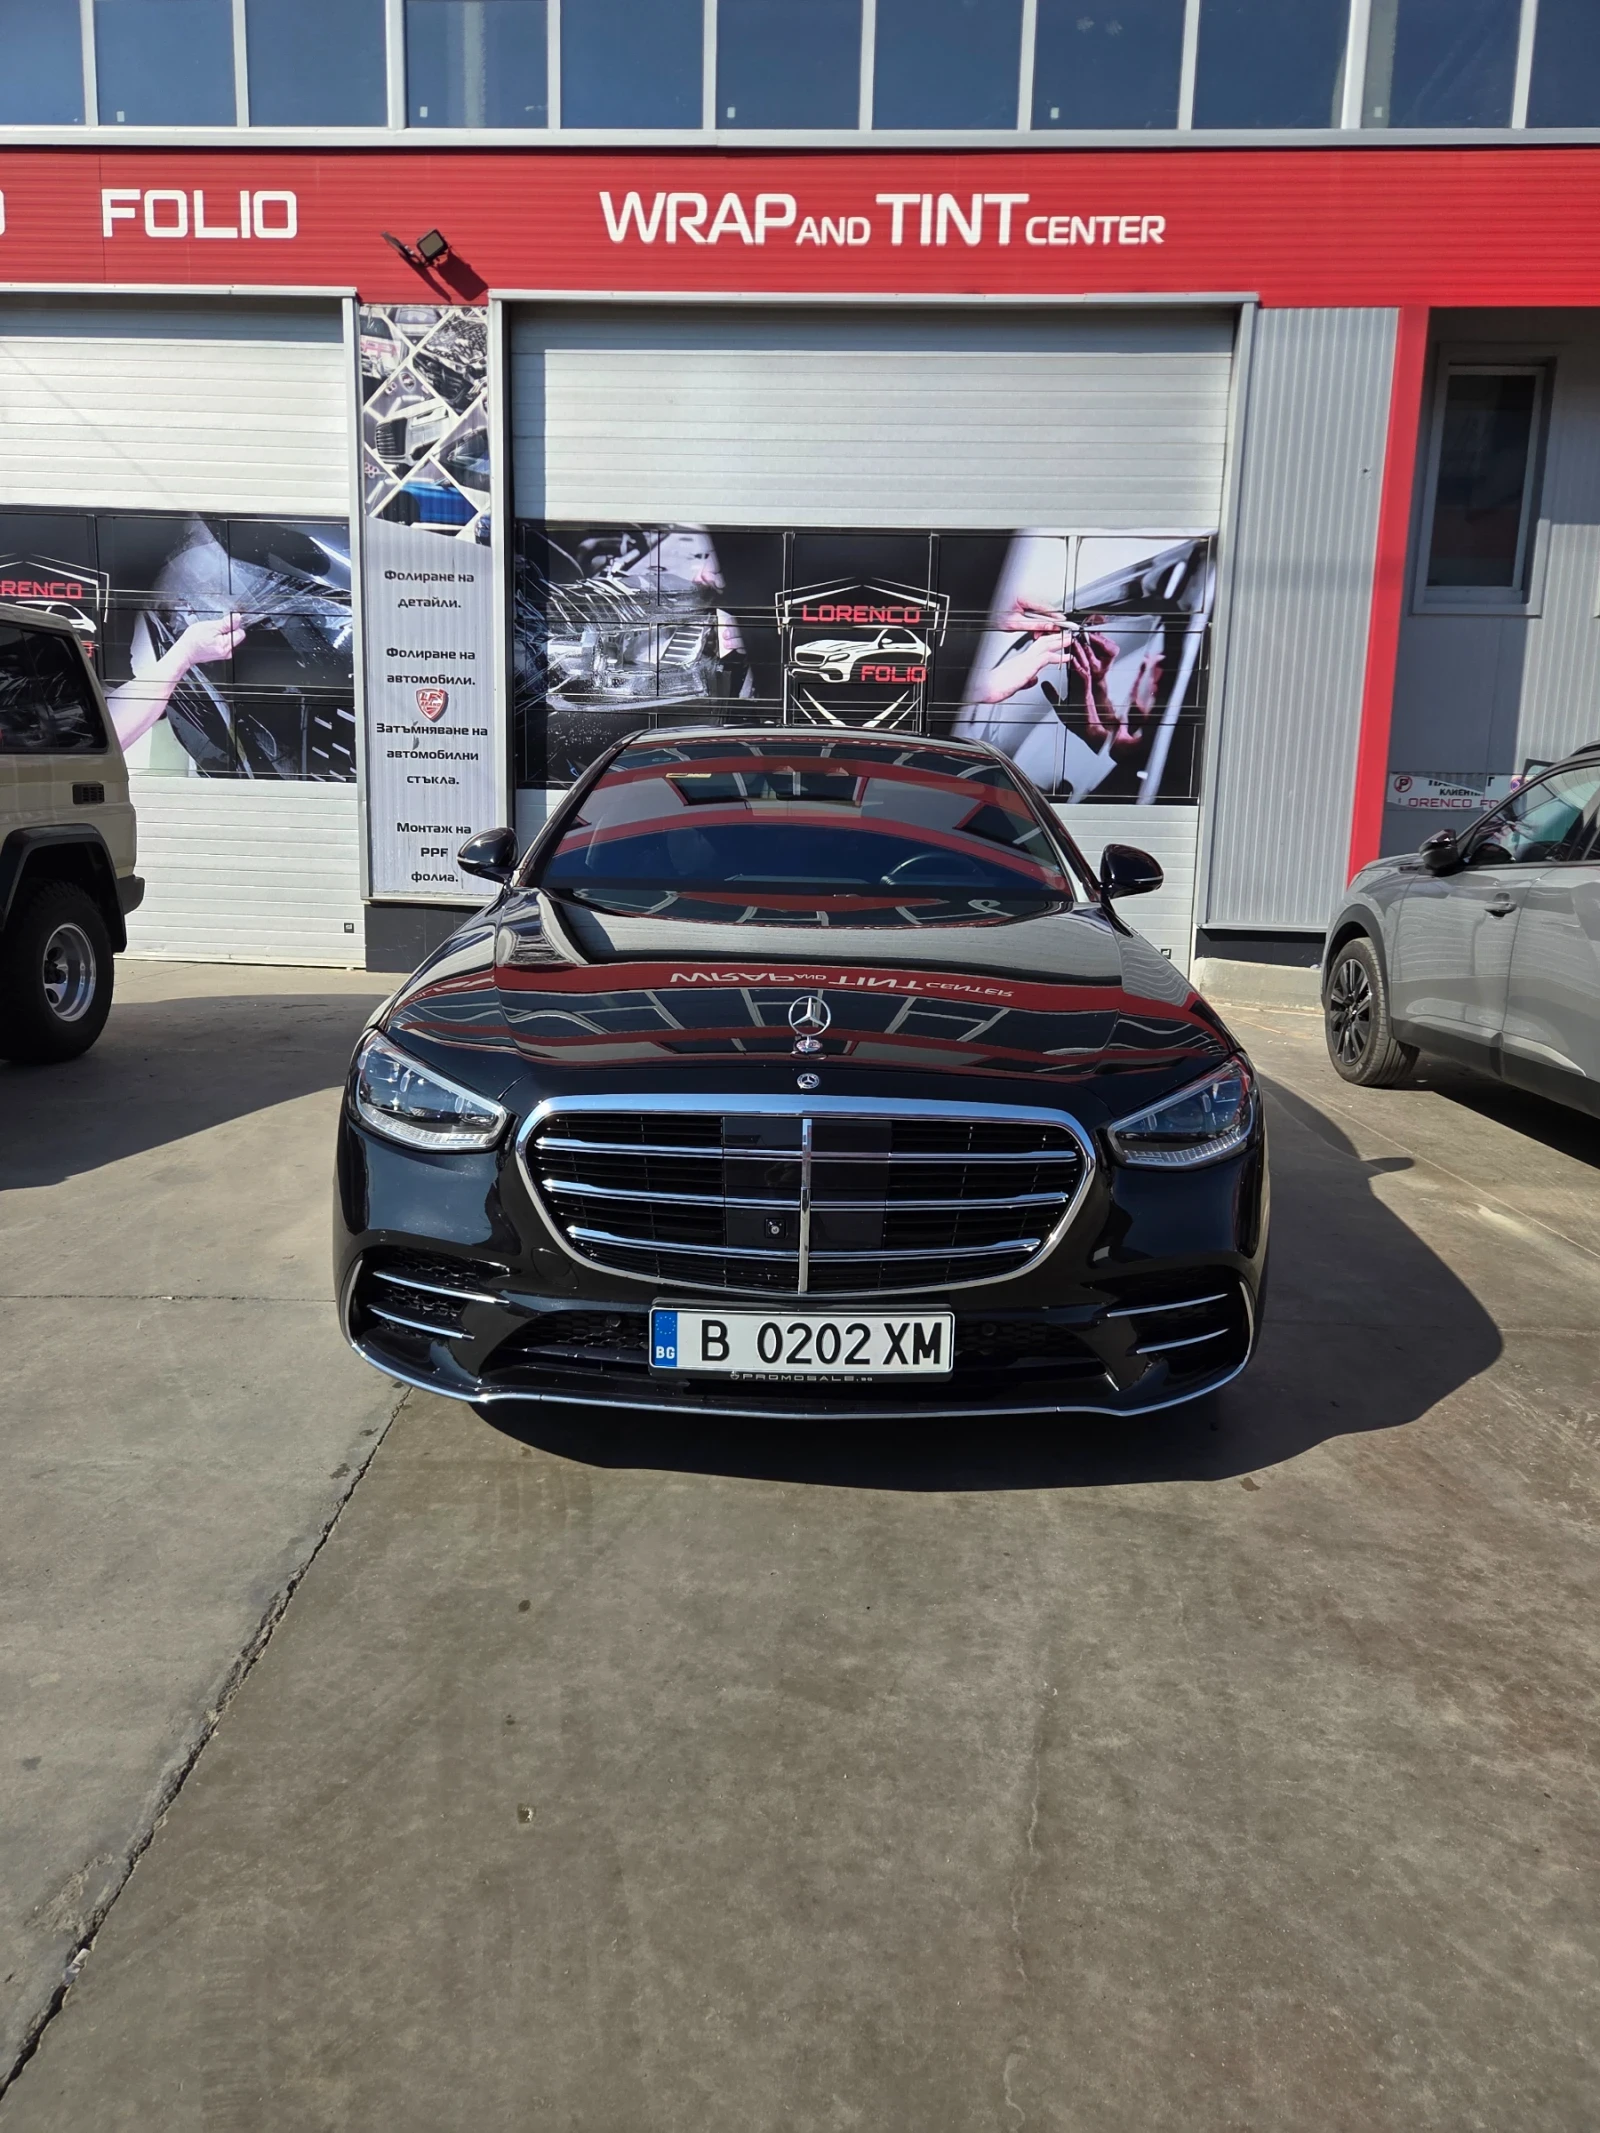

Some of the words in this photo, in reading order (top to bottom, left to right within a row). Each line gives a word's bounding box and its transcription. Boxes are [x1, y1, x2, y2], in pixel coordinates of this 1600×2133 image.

[102, 189, 297, 238] FOLIO
[599, 191, 797, 244] WRAP
[796, 216, 870, 245] AND
[876, 193, 1029, 245] TINT
[1025, 215, 1166, 245] CENTER
[384, 570, 455, 583] Фолиране
[458, 574, 474, 583] на
[398, 597, 461, 609] детайли.
[802, 604, 921, 623] LORENCO
[386, 647, 456, 660] Фолиране
[460, 651, 475, 660] на
[388, 675, 476, 685] автомобили.
[861, 665, 927, 682] FOLIO
[376, 722, 469, 736] Затъмняване
[472, 727, 488, 736] на
[387, 749, 479, 761] автомобилни
[406, 774, 460, 785] стъкла.
[1398, 798, 1472, 808] ORENCO
[396, 822, 453, 834] Монтаж
[456, 825, 472, 834] на
[420, 847, 449, 858] PPF
[411, 872, 459, 884] фолиа.
[701, 1319, 730, 1362] B
[757, 1321, 871, 1365] 0202
[882, 1322, 943, 1365] XM
[655, 1346, 676, 1359] BG
